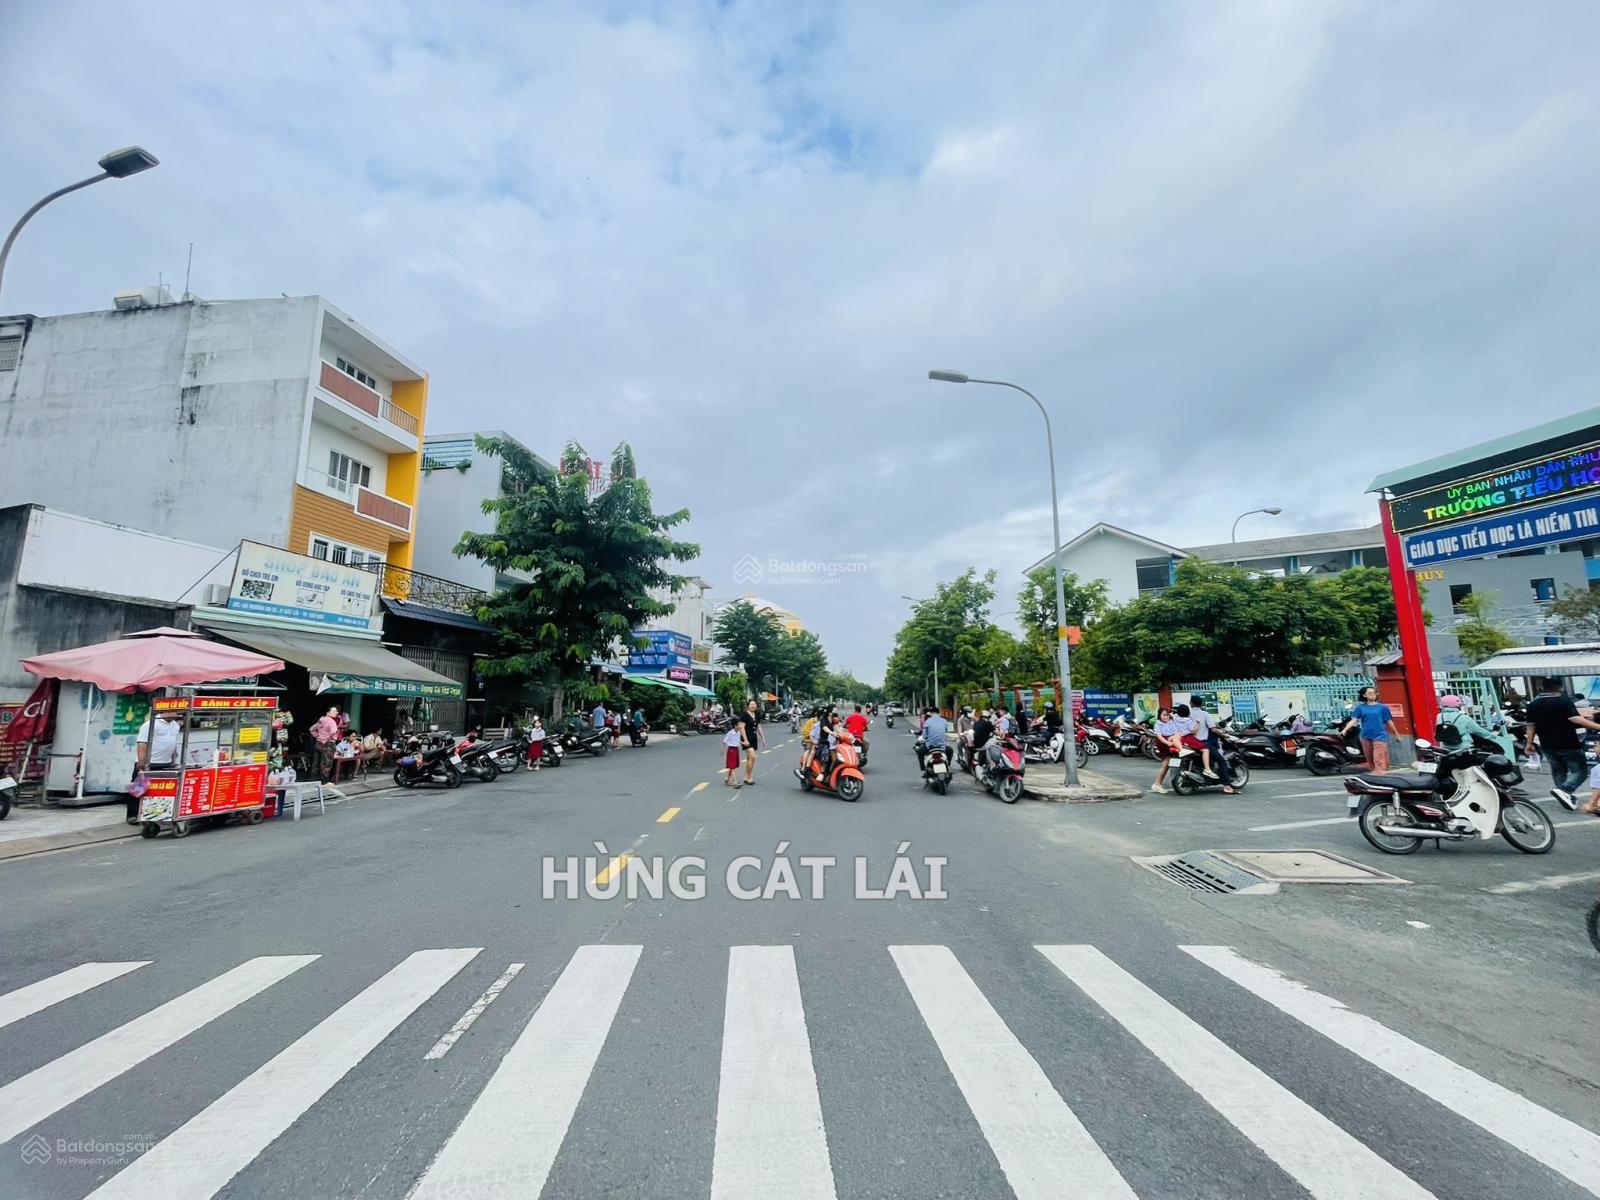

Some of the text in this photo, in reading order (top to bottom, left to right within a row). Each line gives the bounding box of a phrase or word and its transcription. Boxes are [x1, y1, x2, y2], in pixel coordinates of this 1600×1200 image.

[1466, 481, 1491, 494] BAN
[1494, 469, 1531, 487] NHÂN
[1536, 459, 1565, 476] DÂN
[1423, 491, 1506, 520] TRƯỜNG
[1409, 508, 1599, 560] GIÁO DỤC TIỂU HỌC LÀ NIỀM TIN
